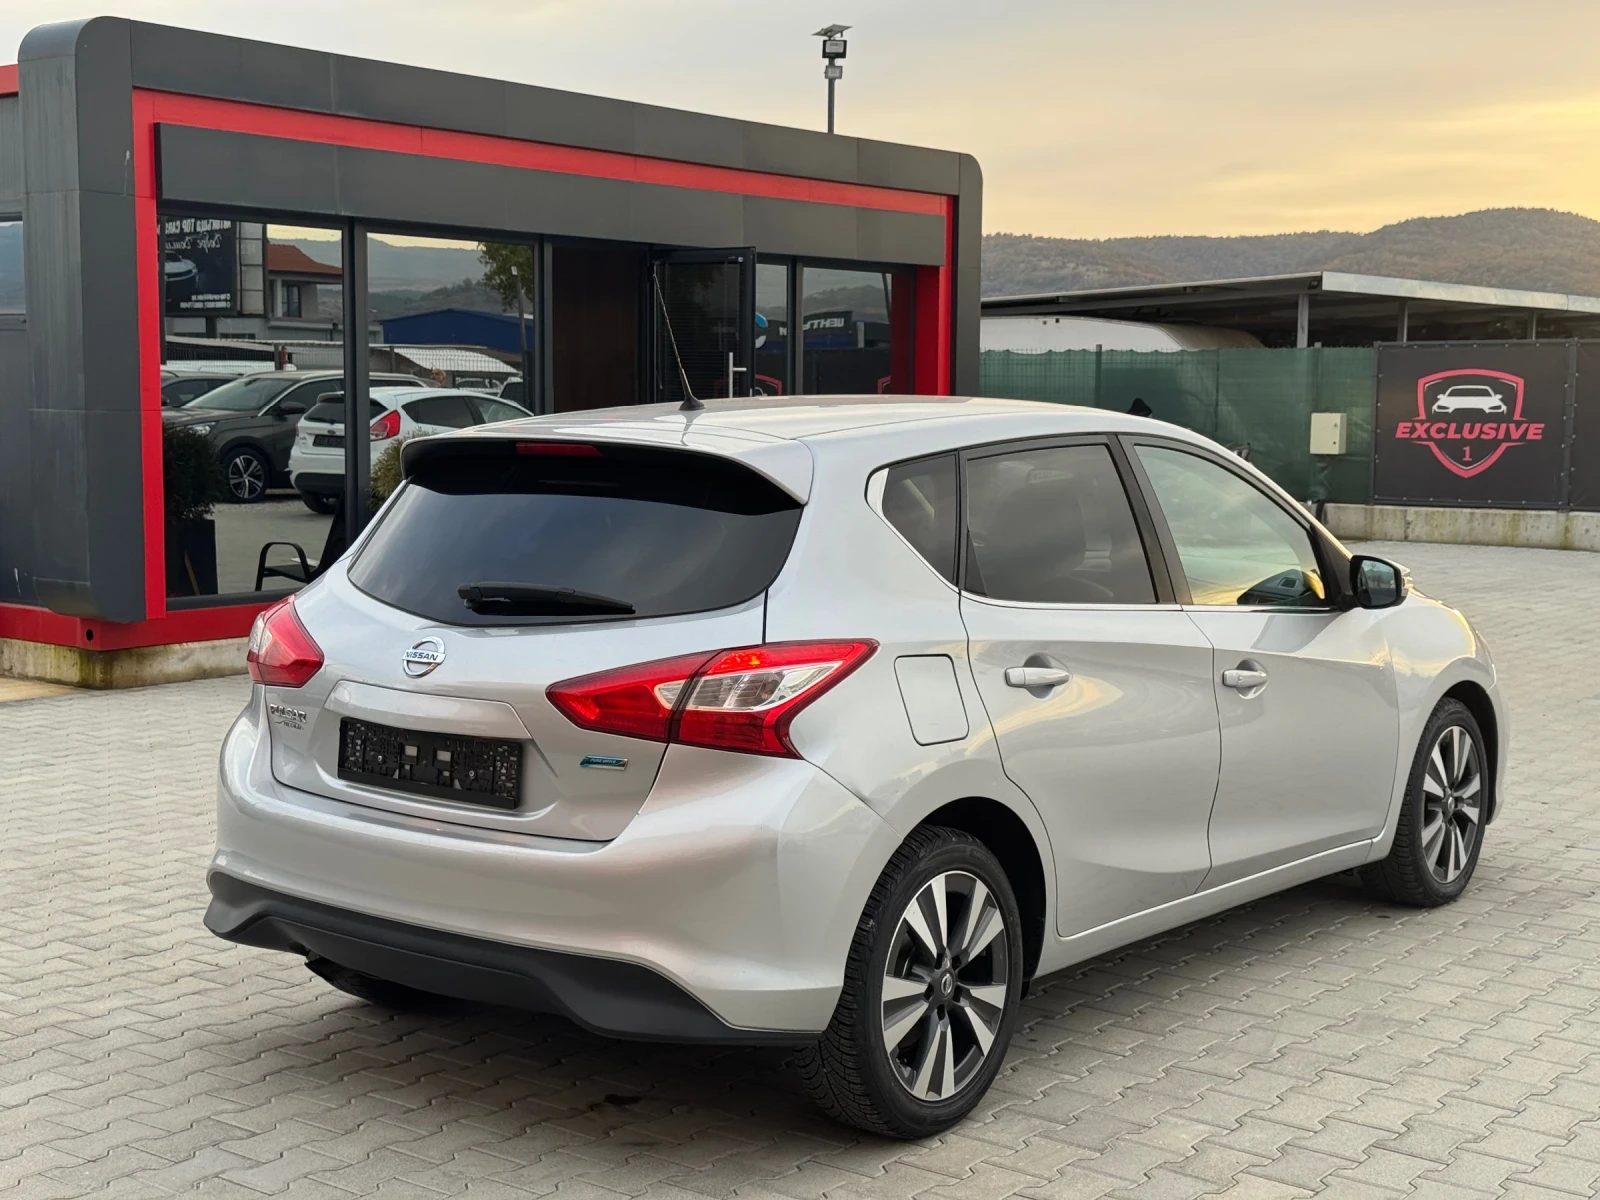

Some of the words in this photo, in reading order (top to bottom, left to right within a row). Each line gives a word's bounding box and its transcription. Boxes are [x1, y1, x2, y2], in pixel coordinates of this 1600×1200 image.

[1395, 422, 1545, 439] EXCLUSIVE
[1462, 446, 1472, 461] 1
[405, 651, 439, 661] NISSAN
[269, 703, 307, 723] PULSAR
